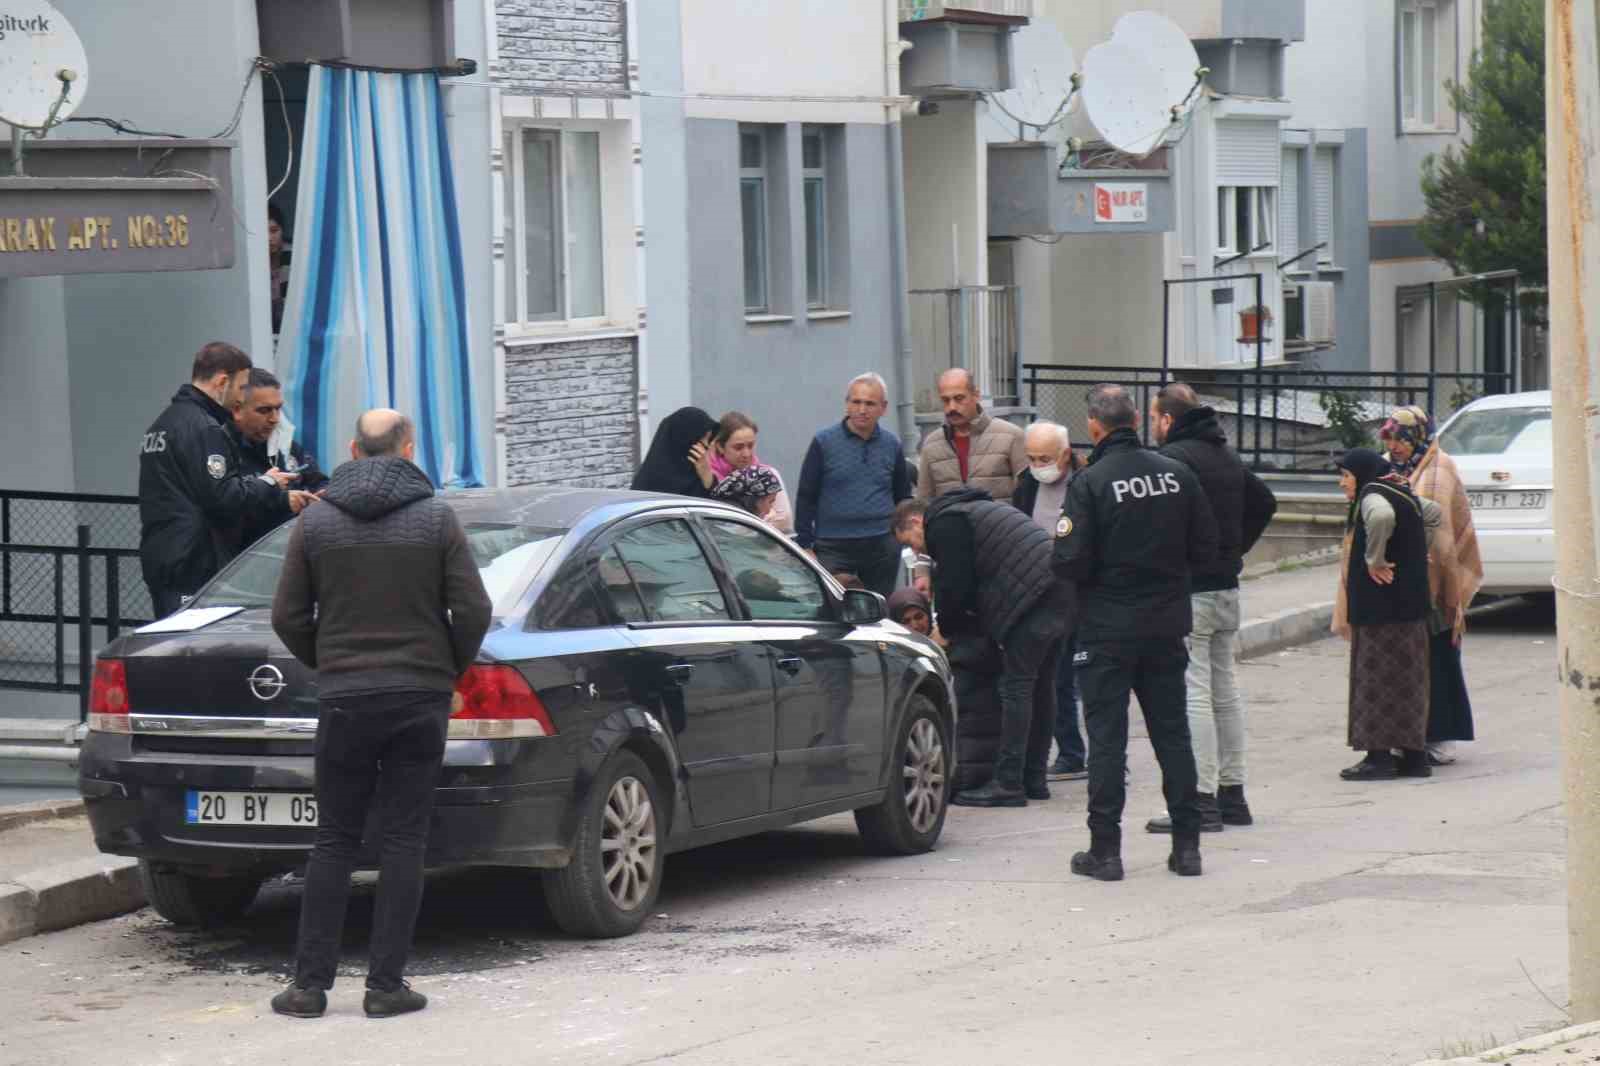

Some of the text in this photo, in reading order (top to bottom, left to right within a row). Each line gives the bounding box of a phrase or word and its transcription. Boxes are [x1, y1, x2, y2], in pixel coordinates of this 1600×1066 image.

[68, 216, 118, 250] APT.
[127, 214, 189, 249] NO:36
[1519, 493, 1543, 506] 237
[201, 795, 316, 822] 20 BY 05
